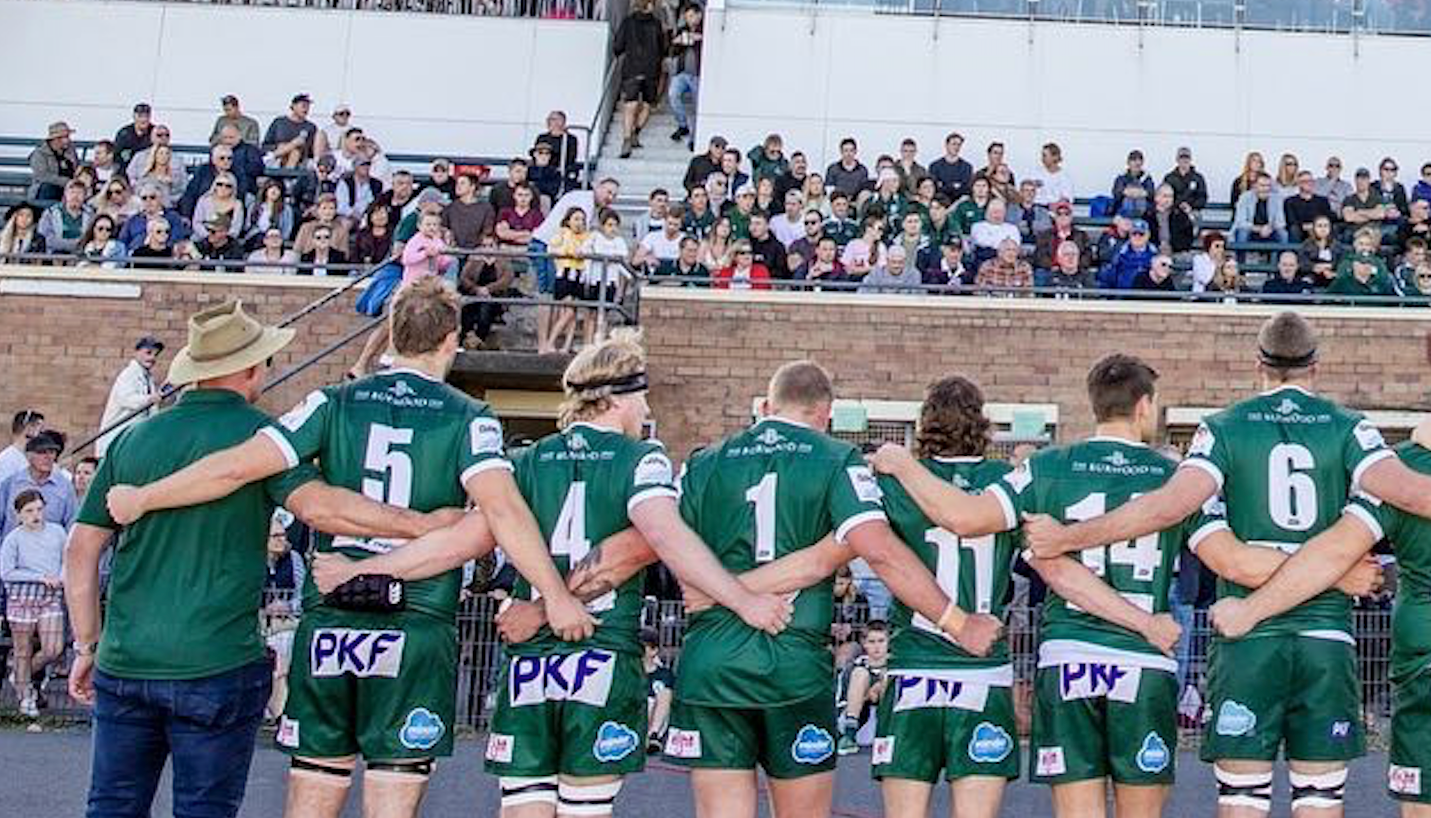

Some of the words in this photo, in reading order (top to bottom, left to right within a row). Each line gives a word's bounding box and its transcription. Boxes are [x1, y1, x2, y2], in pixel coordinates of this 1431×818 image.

[362, 422, 414, 509] 5
[1268, 442, 1318, 531] 6
[551, 481, 591, 569] 4
[746, 472, 778, 562] 1
[1065, 492, 1163, 581] 14
[924, 527, 996, 614] 11
[315, 633, 401, 672] PKF
[514, 650, 612, 701] PKF
